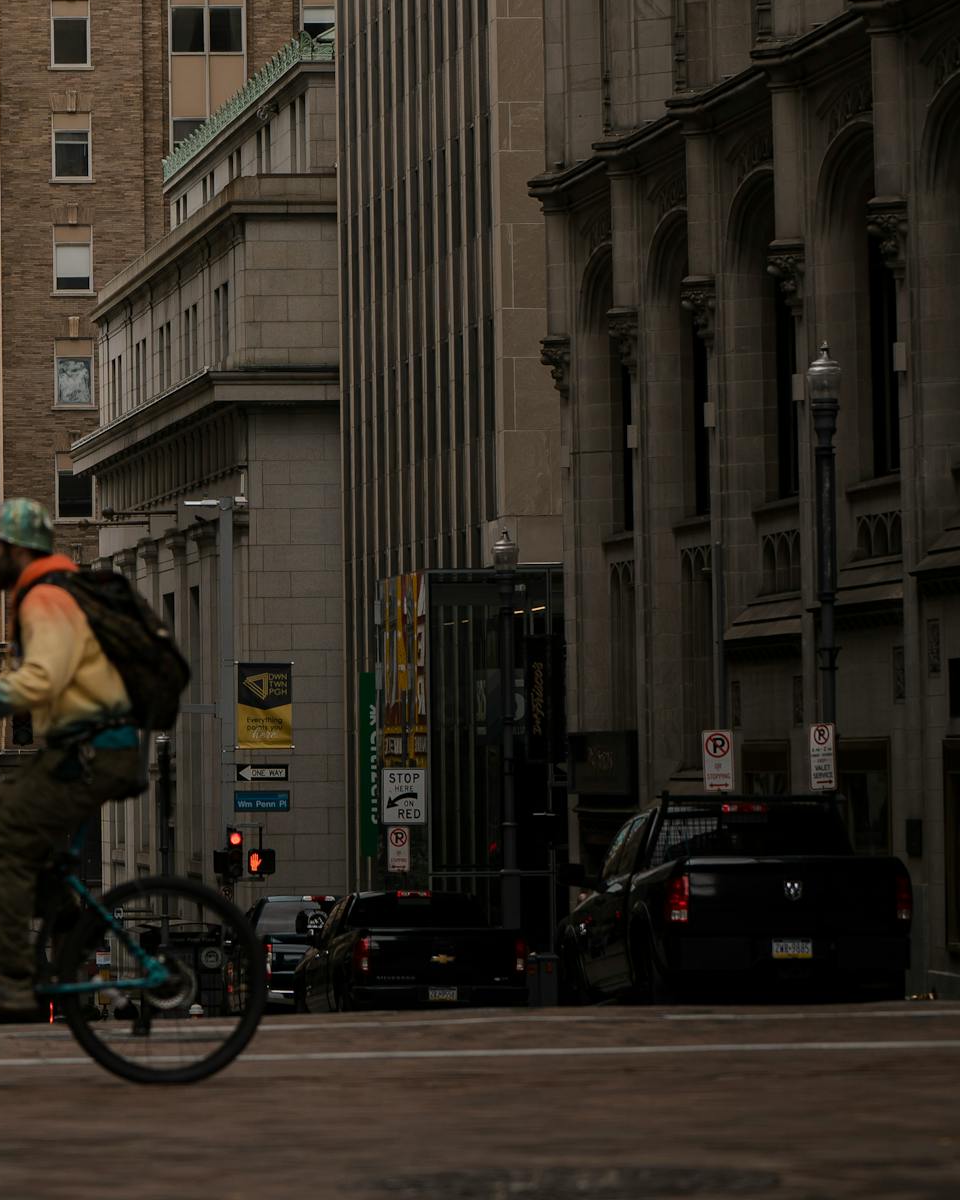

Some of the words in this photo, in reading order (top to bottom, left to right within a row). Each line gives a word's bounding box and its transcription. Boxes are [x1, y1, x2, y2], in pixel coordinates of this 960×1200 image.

[269, 688, 288, 696] PGH
[389, 773, 420, 783] STOP
[237, 800, 253, 808] Wm
[256, 800, 276, 808] Penn
[398, 809, 421, 819] RED
